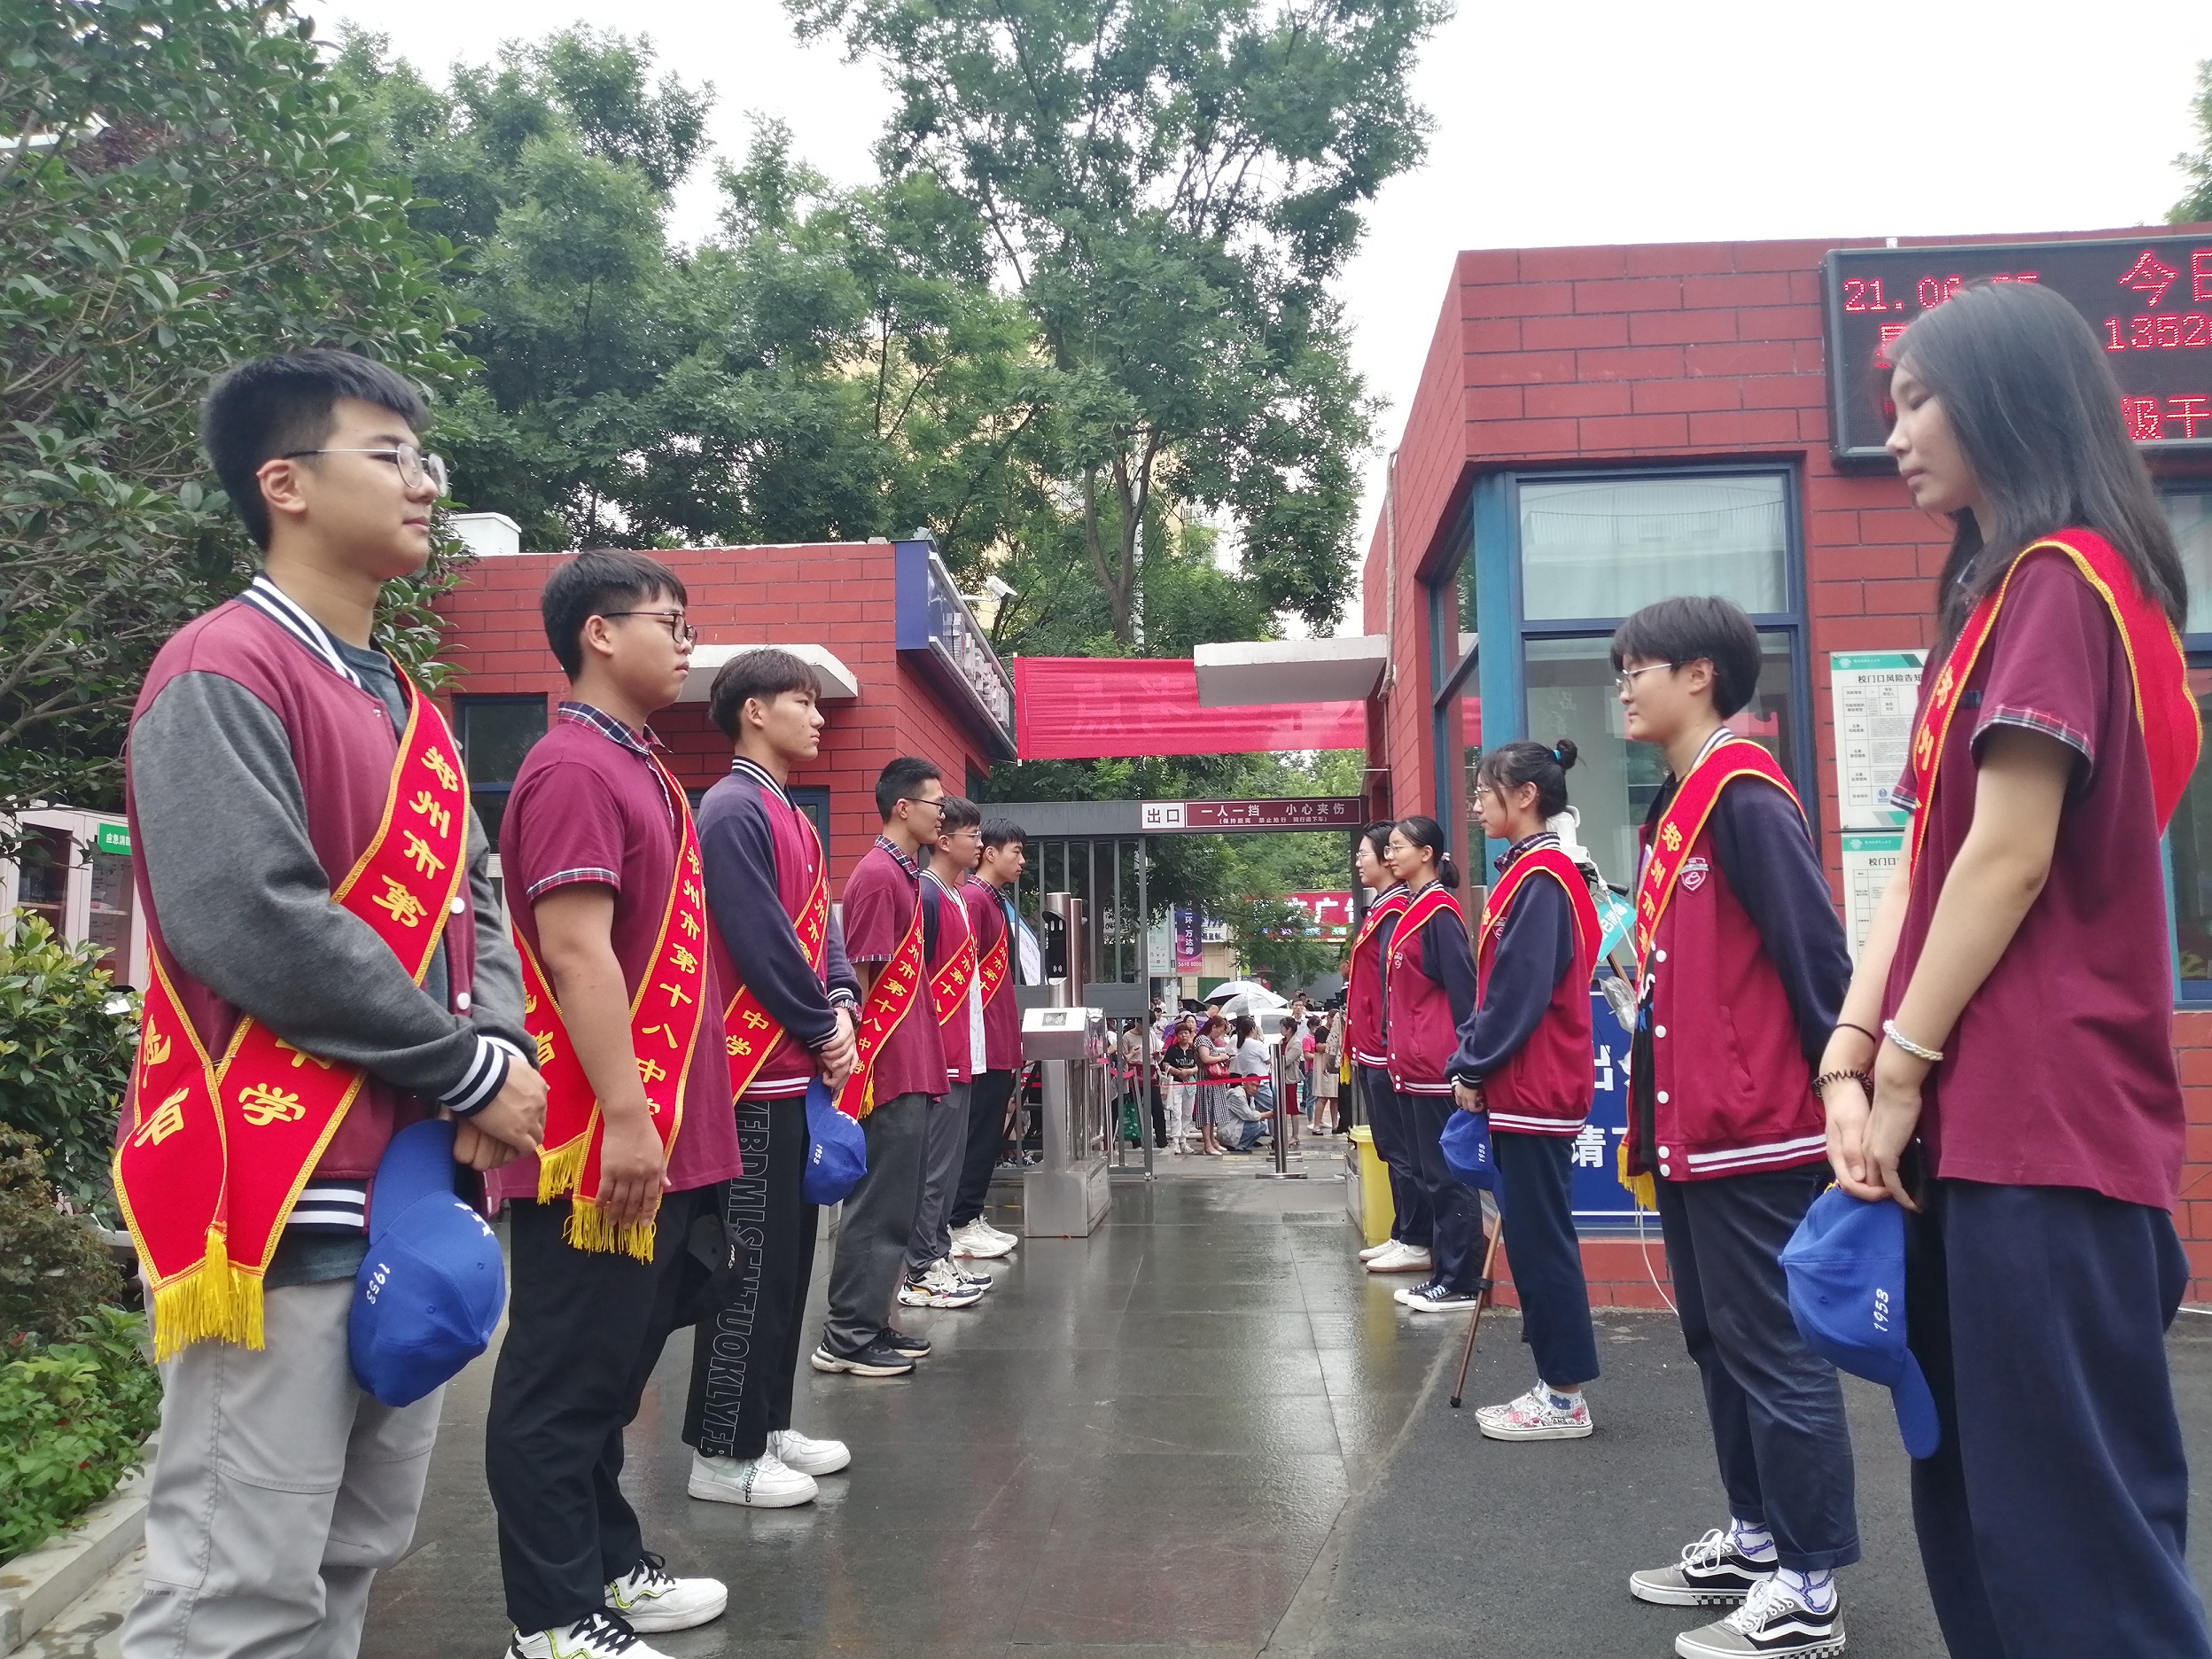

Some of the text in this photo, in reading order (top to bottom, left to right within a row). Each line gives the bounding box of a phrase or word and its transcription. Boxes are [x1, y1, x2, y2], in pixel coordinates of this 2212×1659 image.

[2104, 315, 2212, 350] 1352
[1147, 807, 1180, 824] 出口
[1201, 803, 1345, 817] 一人一挡 小心夹伤
[1868, 857, 1899, 867] 校门口
[726, 1009, 769, 1056] 中学
[366, 1263, 391, 1305] 1953
[1873, 1288, 1889, 1332] 1953
